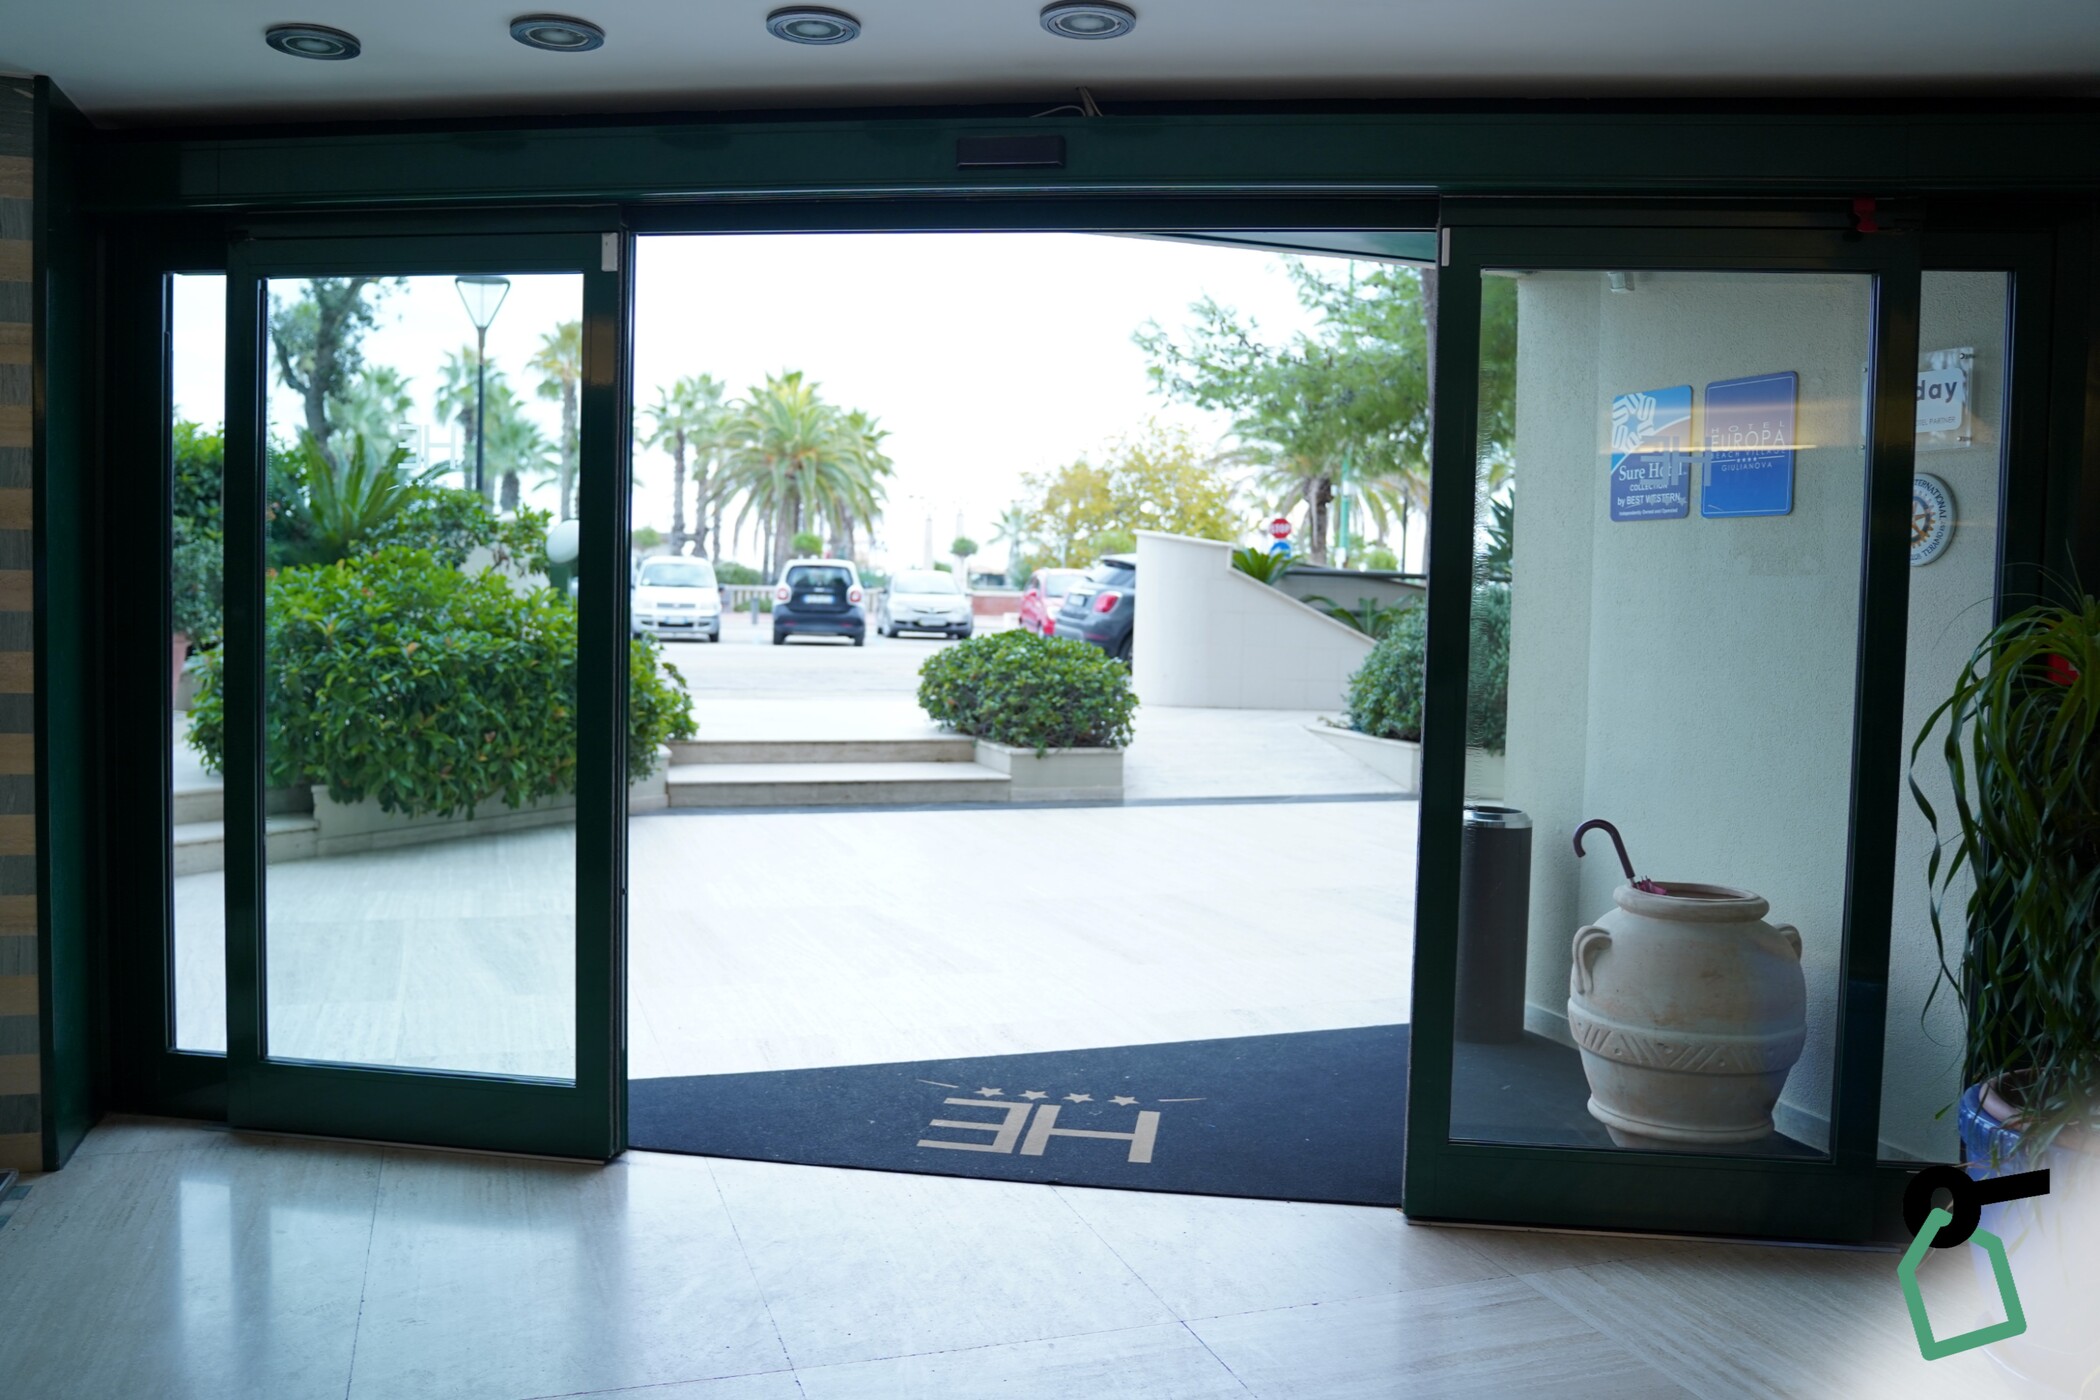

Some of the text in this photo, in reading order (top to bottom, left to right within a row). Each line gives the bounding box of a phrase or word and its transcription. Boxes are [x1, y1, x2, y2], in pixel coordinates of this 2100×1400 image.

[1917, 380, 1957, 403] day
[1711, 421, 1785, 433] HOTEL
[1711, 429, 1785, 451] EUROPA
[1618, 465, 1646, 481] Sure
[1721, 462, 1773, 472] GIULIANOVA
[1617, 492, 1681, 508] by BEST WESTERN
[1269, 523, 1291, 533] STOP
